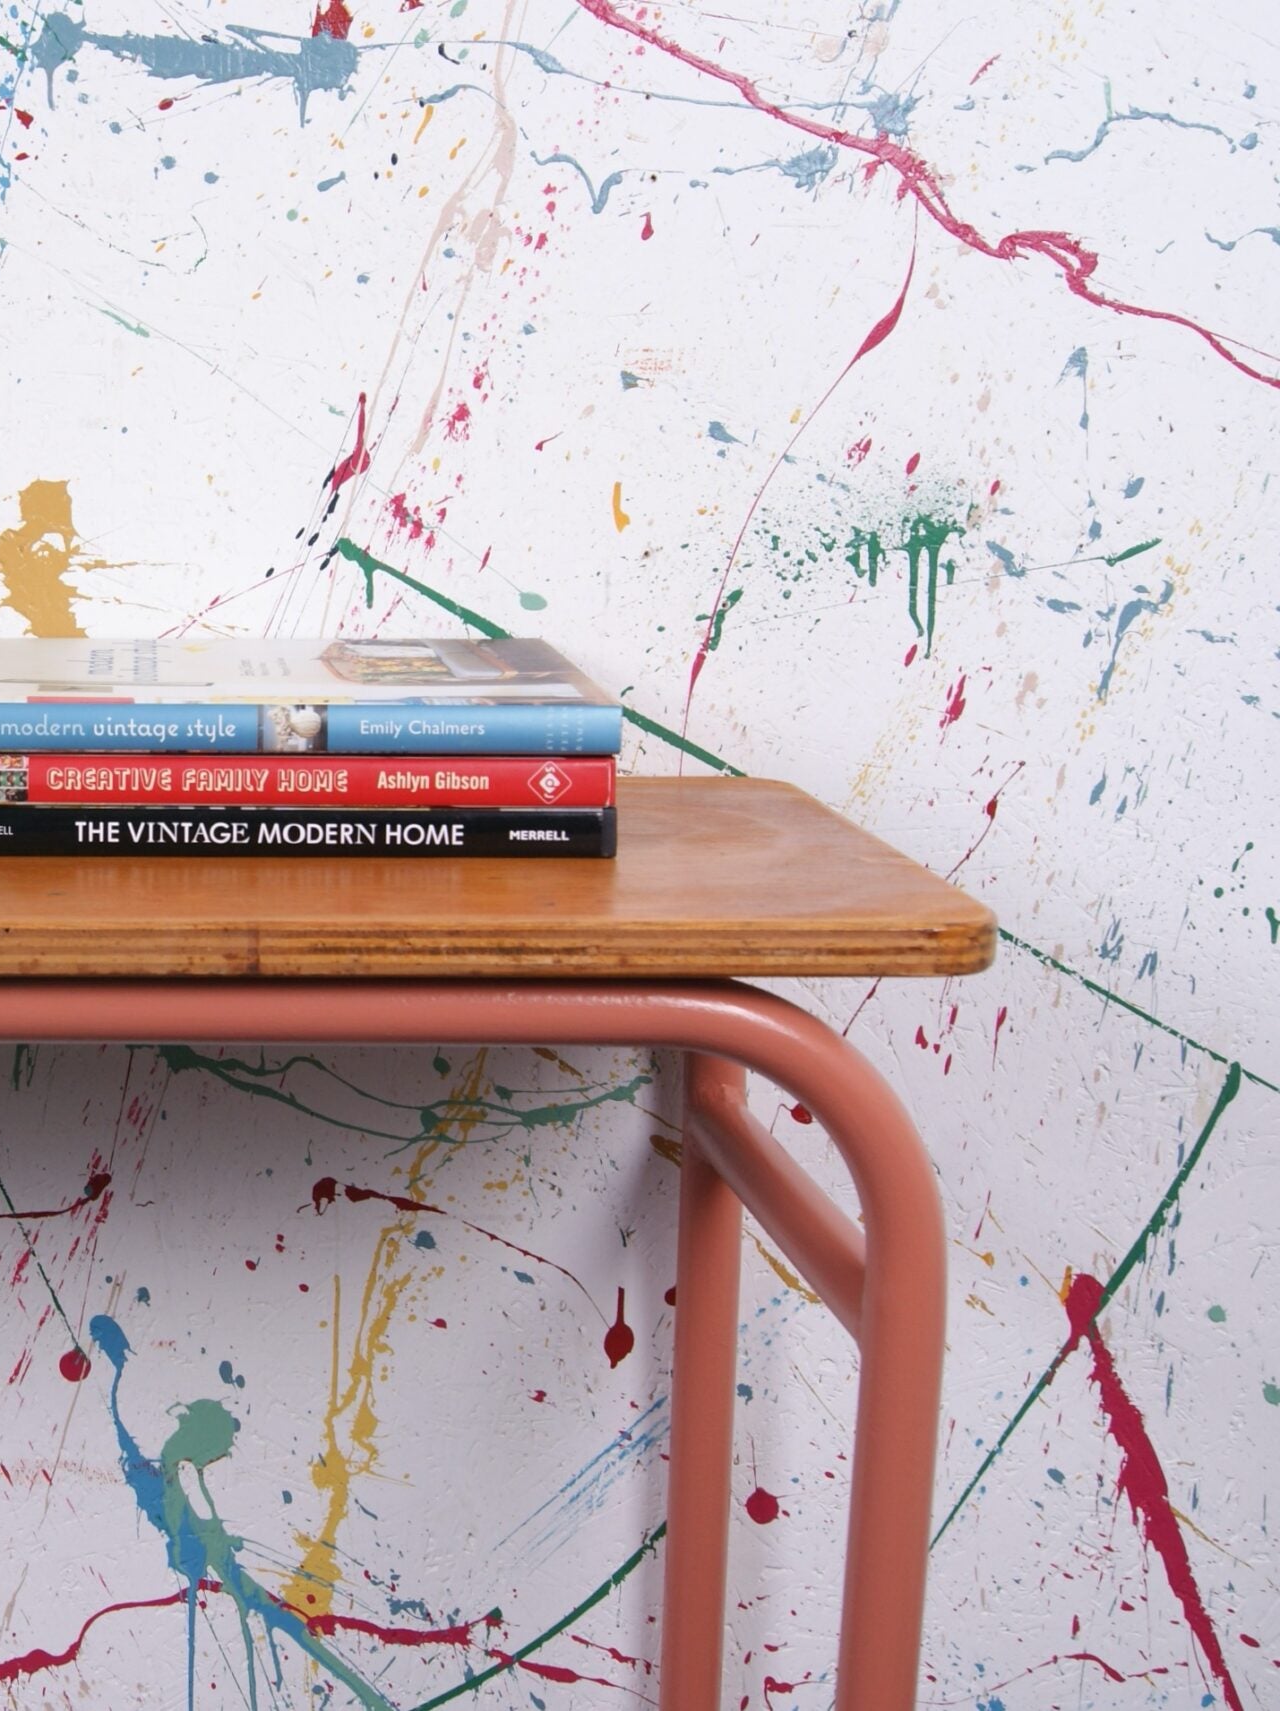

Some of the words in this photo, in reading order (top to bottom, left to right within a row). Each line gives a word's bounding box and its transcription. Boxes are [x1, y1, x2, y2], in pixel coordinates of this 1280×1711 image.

[0, 714, 86, 737] modern
[92, 715, 179, 744] vintage
[186, 714, 237, 743] style
[359, 719, 403, 739] Emily
[408, 719, 486, 736] Chalmers
[46, 767, 172, 792] CREATIVE
[181, 768, 270, 793] FAMILY
[277, 769, 349, 793] HOME
[377, 770, 430, 793] Ashlyn
[434, 770, 490, 791] Gibson
[75, 821, 120, 843] THE
[127, 822, 250, 844] VINTAGE
[257, 823, 377, 845] MODERN
[385, 824, 465, 845] HOME
[509, 830, 570, 842] MERRELL
